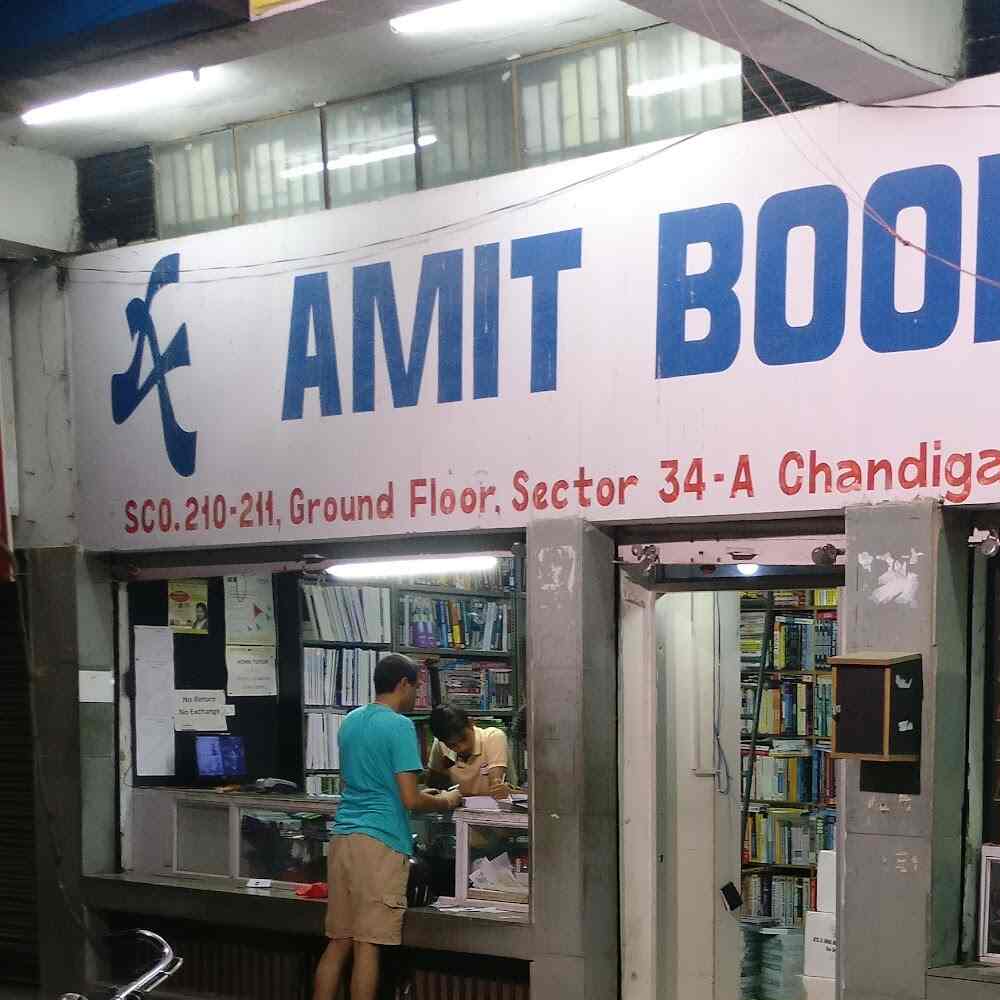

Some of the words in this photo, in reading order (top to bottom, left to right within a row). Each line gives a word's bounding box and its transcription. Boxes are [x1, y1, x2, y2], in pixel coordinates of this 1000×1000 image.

[281, 227, 583, 421] AMIT
[289, 481, 394, 526] Ground
[512, 466, 640, 512] Sector
[658, 454, 754, 503] 34-A
